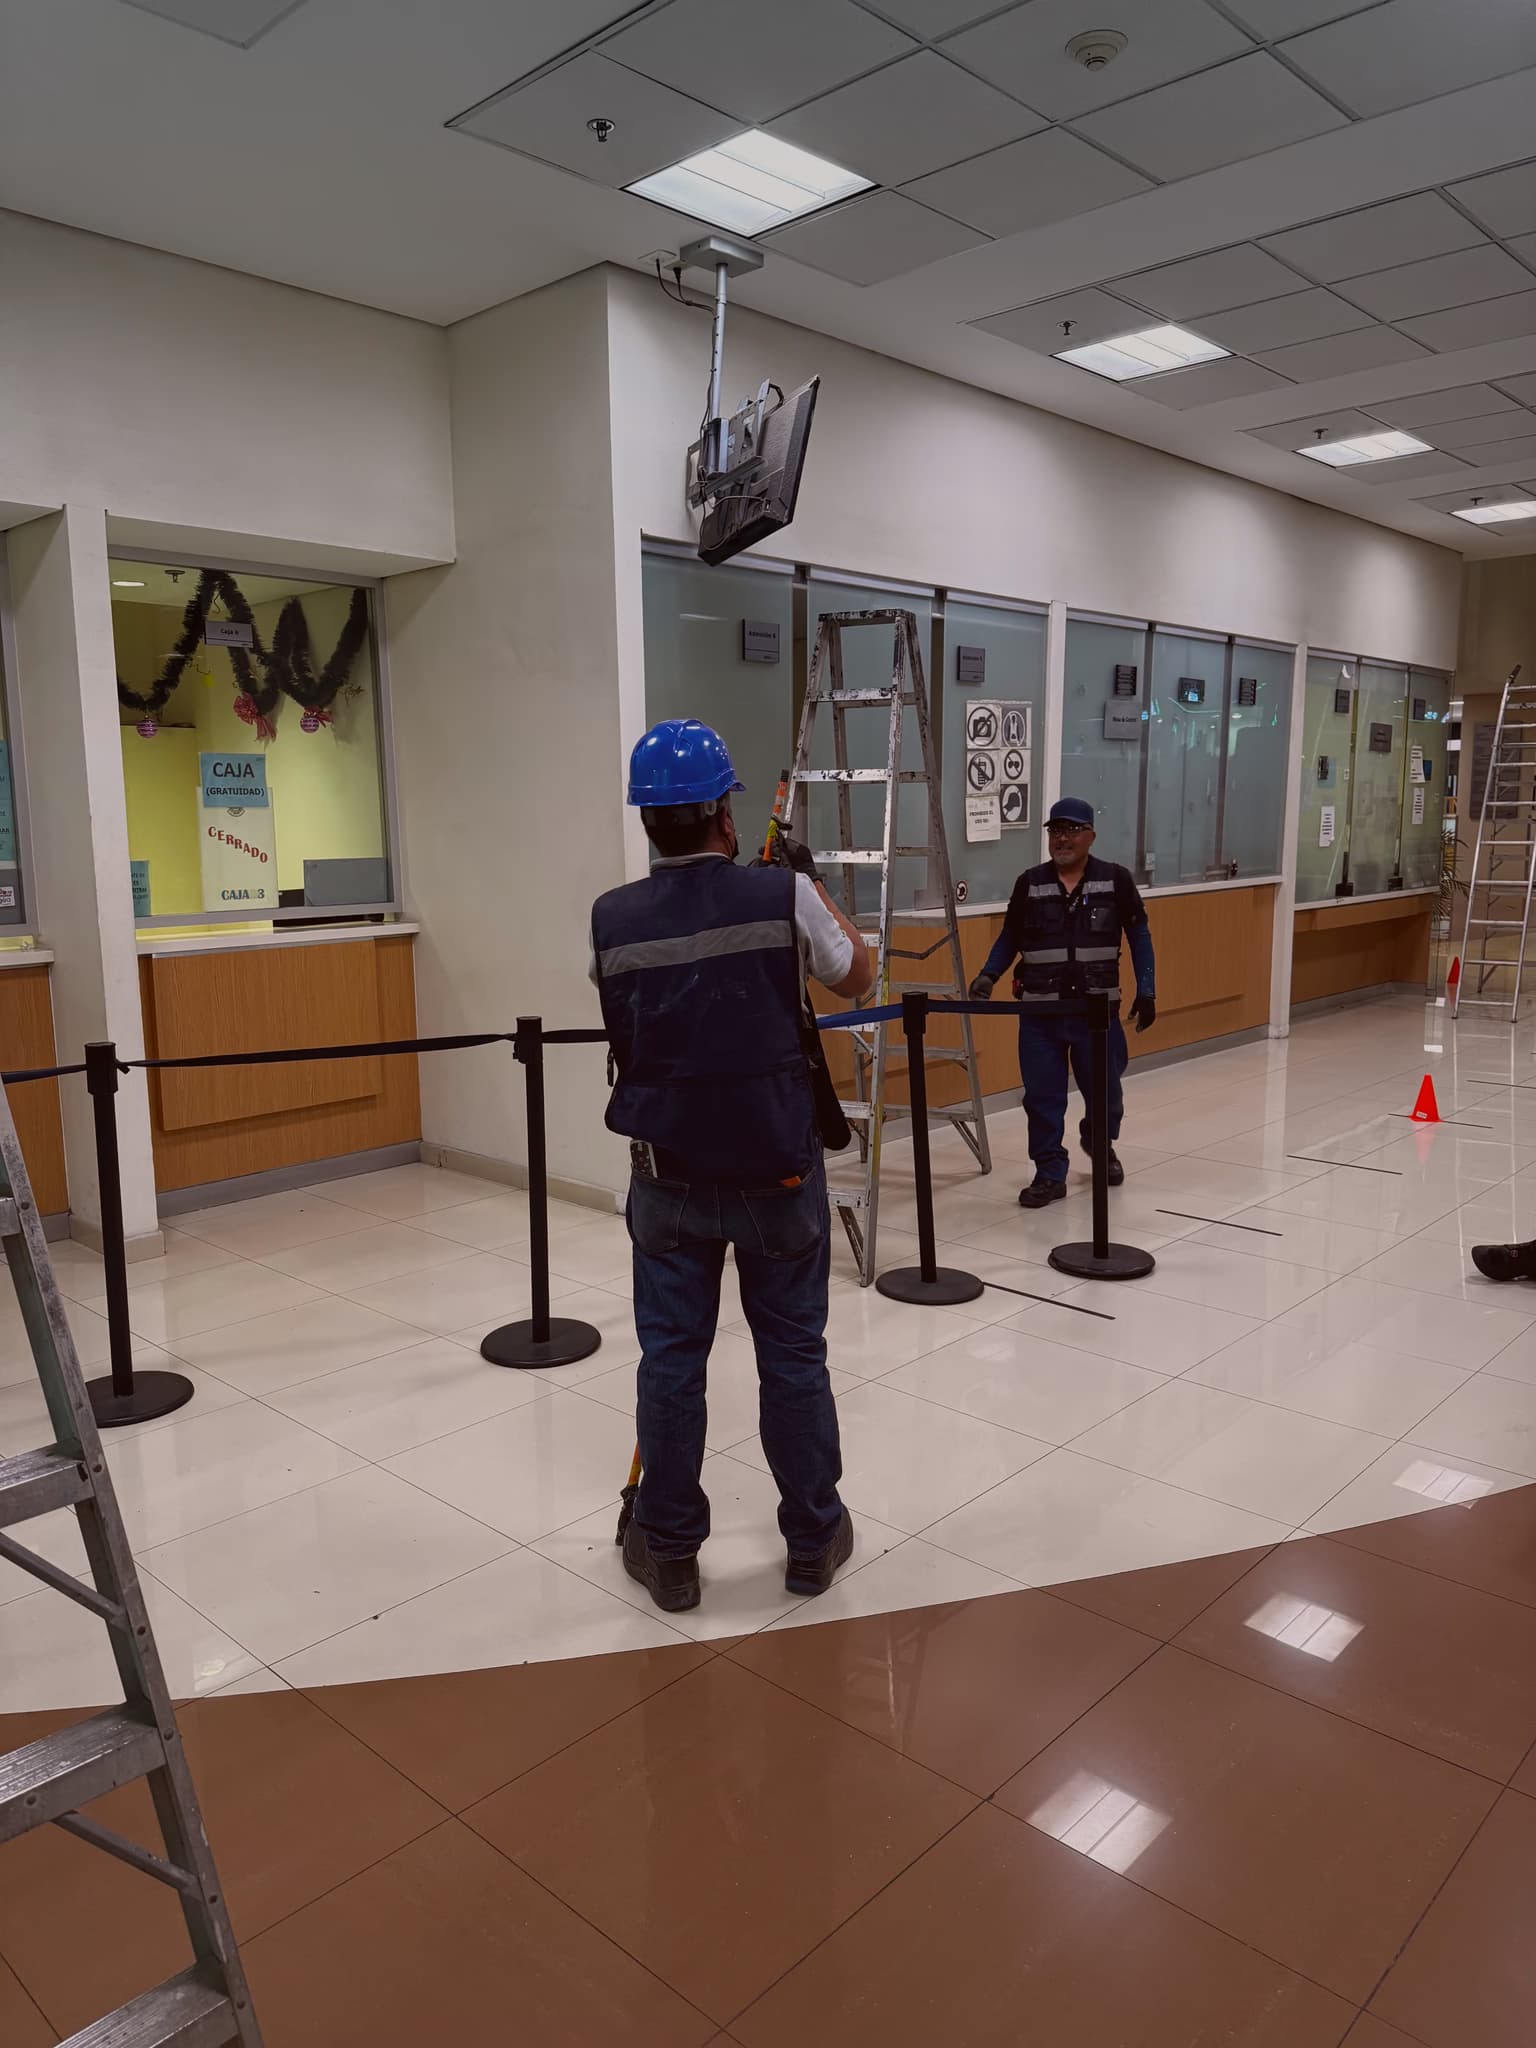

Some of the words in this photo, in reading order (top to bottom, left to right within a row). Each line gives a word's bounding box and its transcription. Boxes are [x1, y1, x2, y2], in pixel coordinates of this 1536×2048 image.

[212, 762, 255, 778] CAJA
[206, 787, 265, 797] (GRATUIDAD)
[208, 826, 268, 864] CERRADO
[221, 889, 250, 901] CAJA
[257, 888, 265, 899] 3
